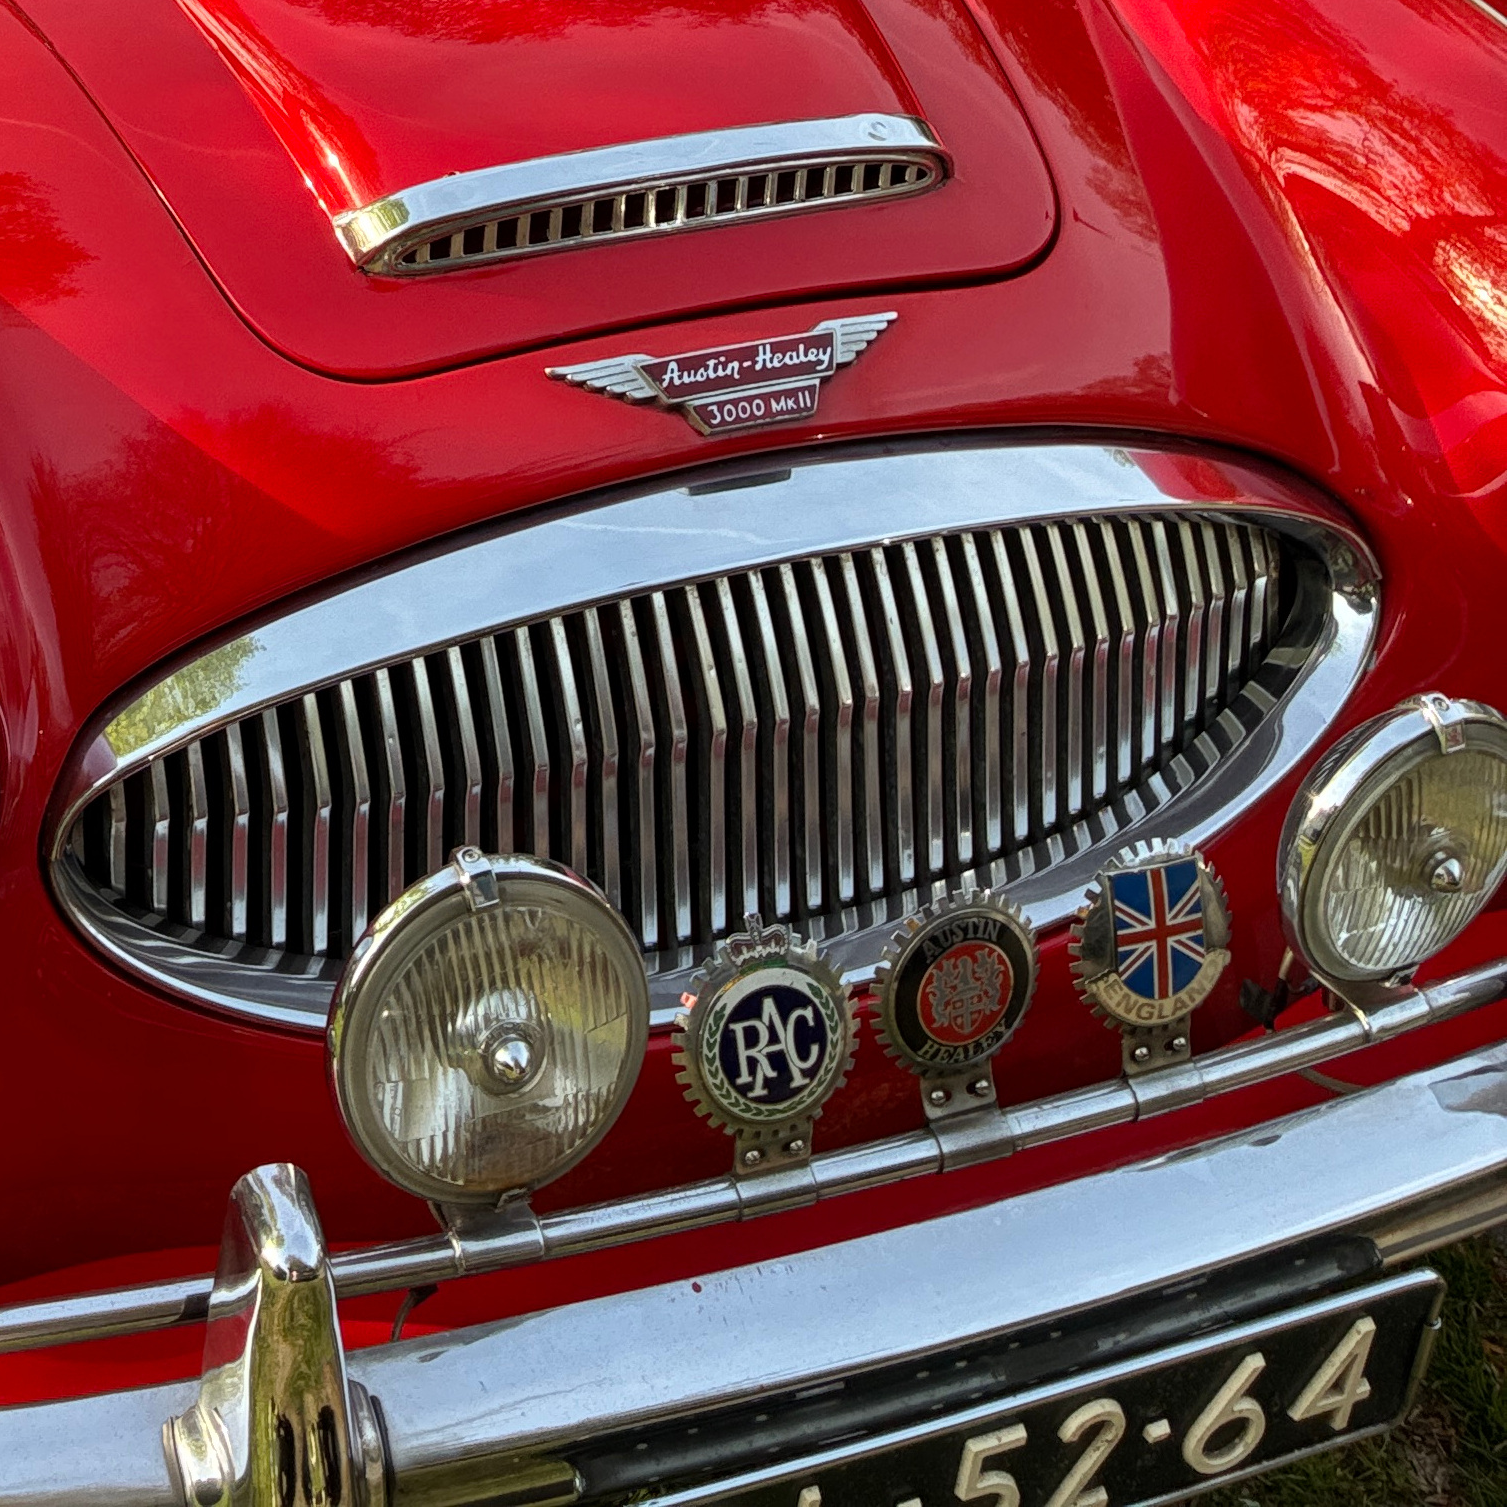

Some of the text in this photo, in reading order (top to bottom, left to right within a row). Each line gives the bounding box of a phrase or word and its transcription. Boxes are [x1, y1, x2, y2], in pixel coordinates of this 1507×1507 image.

[661, 343, 832, 388] Austin-Healey
[706, 398, 765, 425] 3000
[923, 916, 1002, 964] AUSTIN
[1102, 958, 1220, 1021] ENGLAND
[728, 994, 820, 1098] RAC
[915, 1017, 1008, 1064] HEALEY
